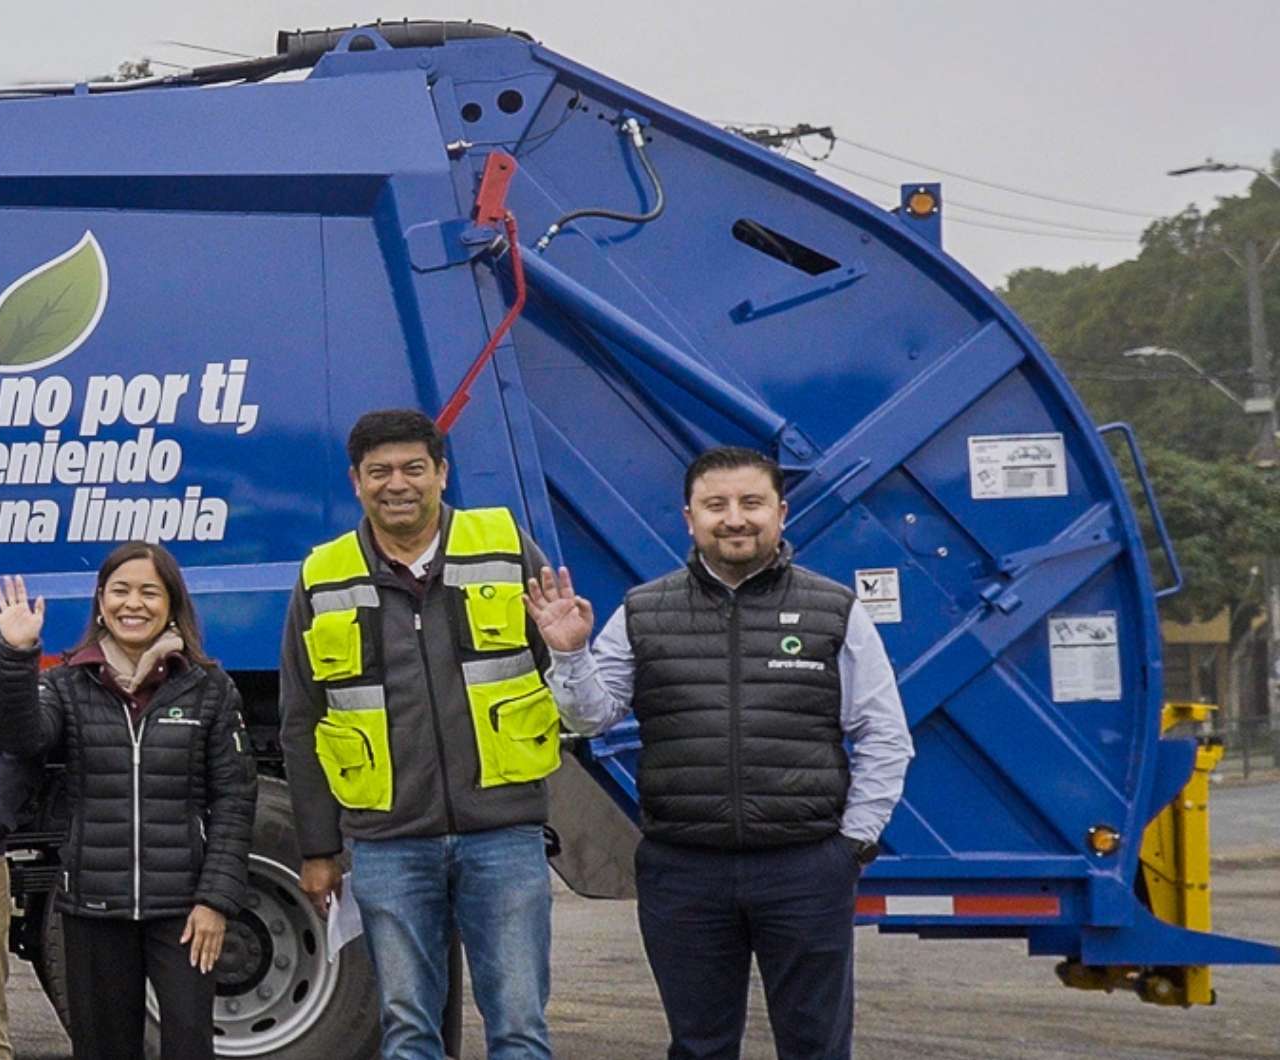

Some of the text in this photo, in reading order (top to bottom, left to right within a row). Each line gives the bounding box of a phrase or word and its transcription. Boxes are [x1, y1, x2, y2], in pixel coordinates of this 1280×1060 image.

[79, 373, 190, 436] por
[197, 358, 260, 435] ti,
[67, 485, 228, 545] limpia
